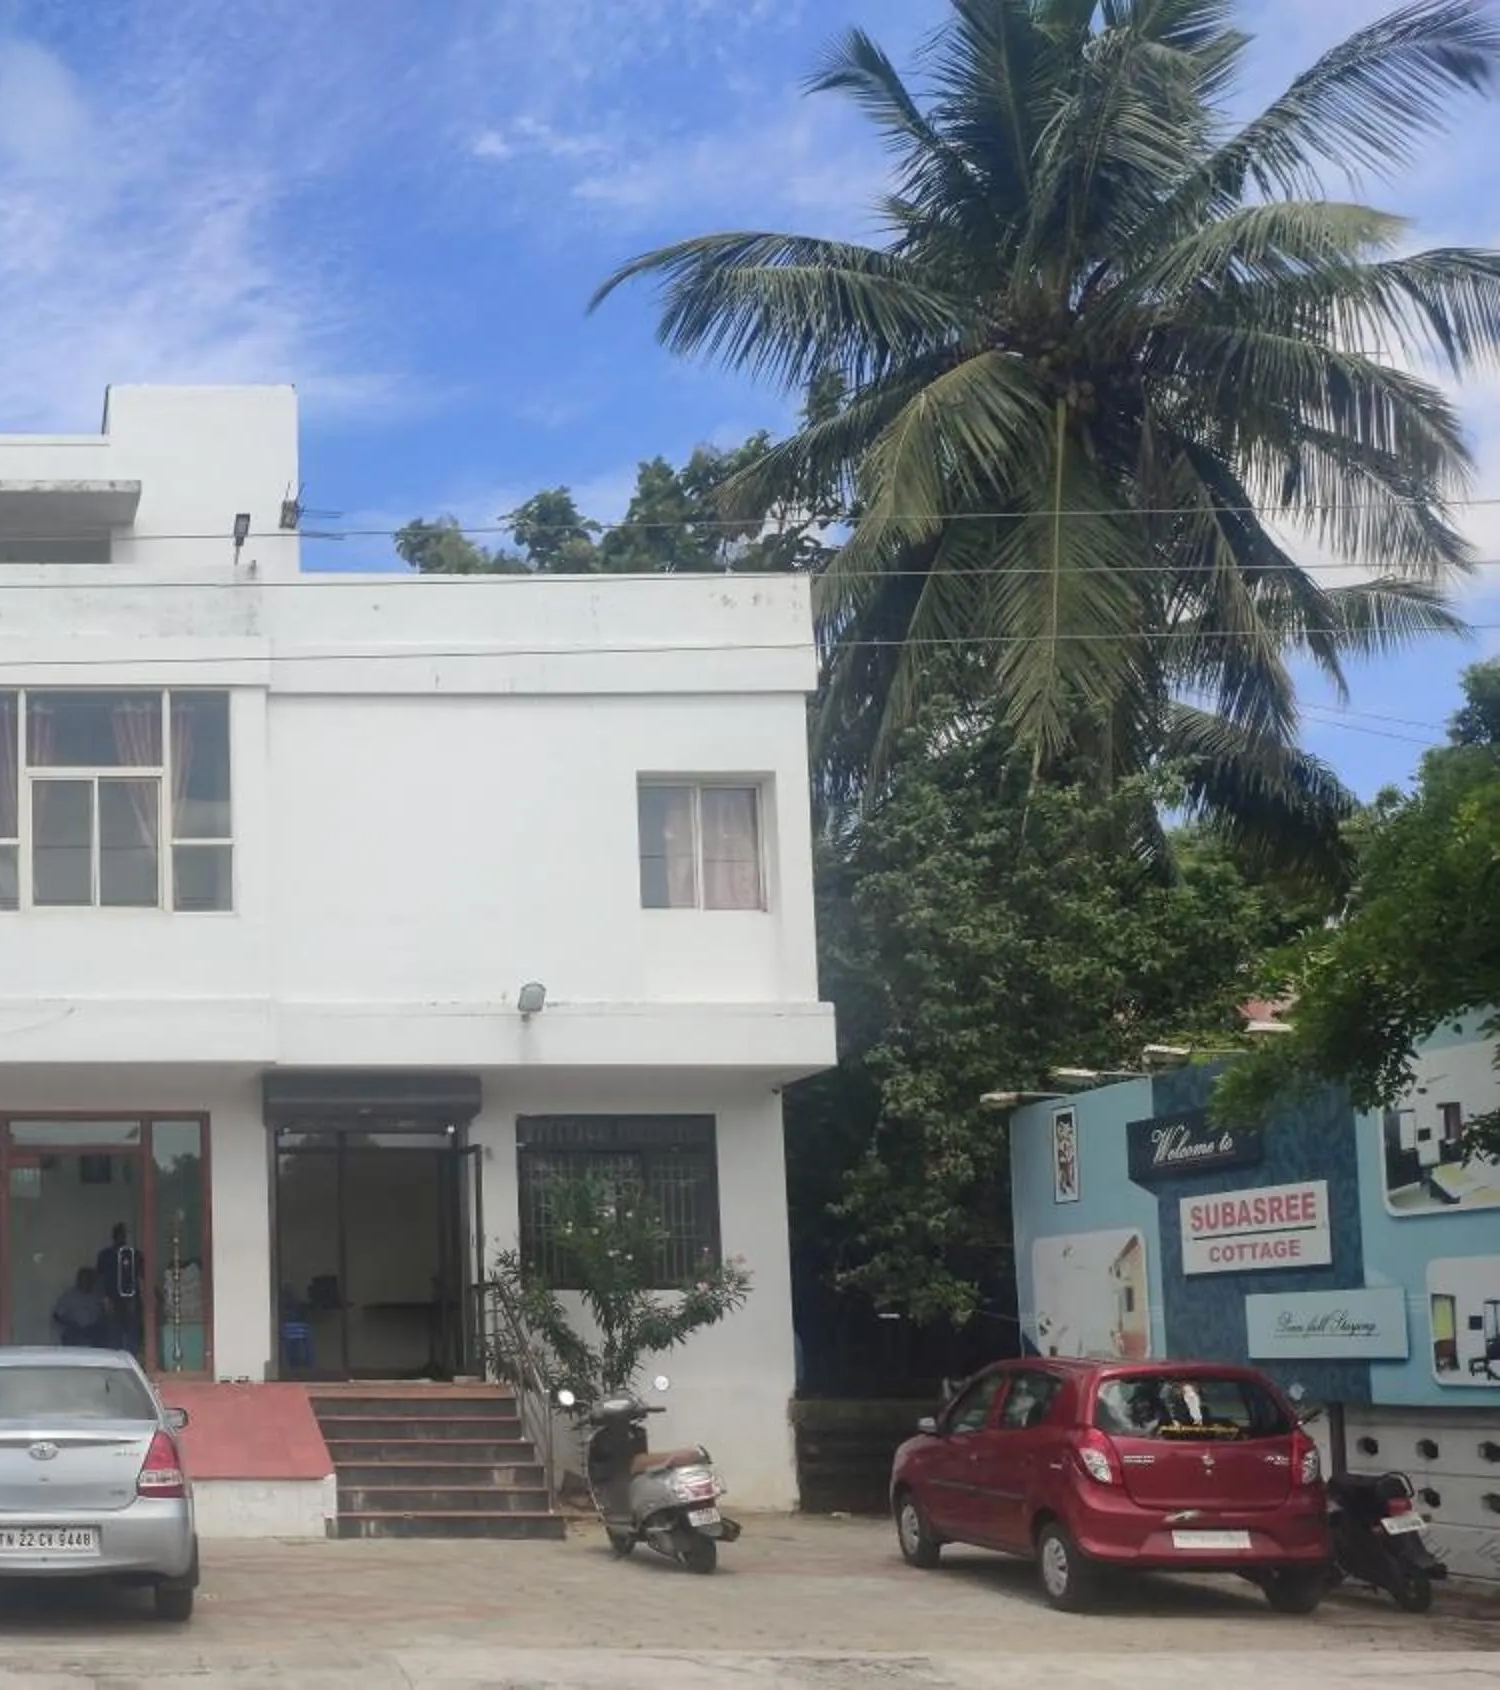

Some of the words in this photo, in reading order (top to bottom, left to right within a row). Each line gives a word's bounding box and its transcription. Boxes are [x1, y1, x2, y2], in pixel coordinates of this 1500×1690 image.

[1151, 1125, 1215, 1165] Welcome
[1219, 1131, 1234, 1152] to
[1190, 1191, 1317, 1232] SUBASREE
[1209, 1238, 1302, 1263] COTTAGE
[20, 1533, 34, 1546] 22
